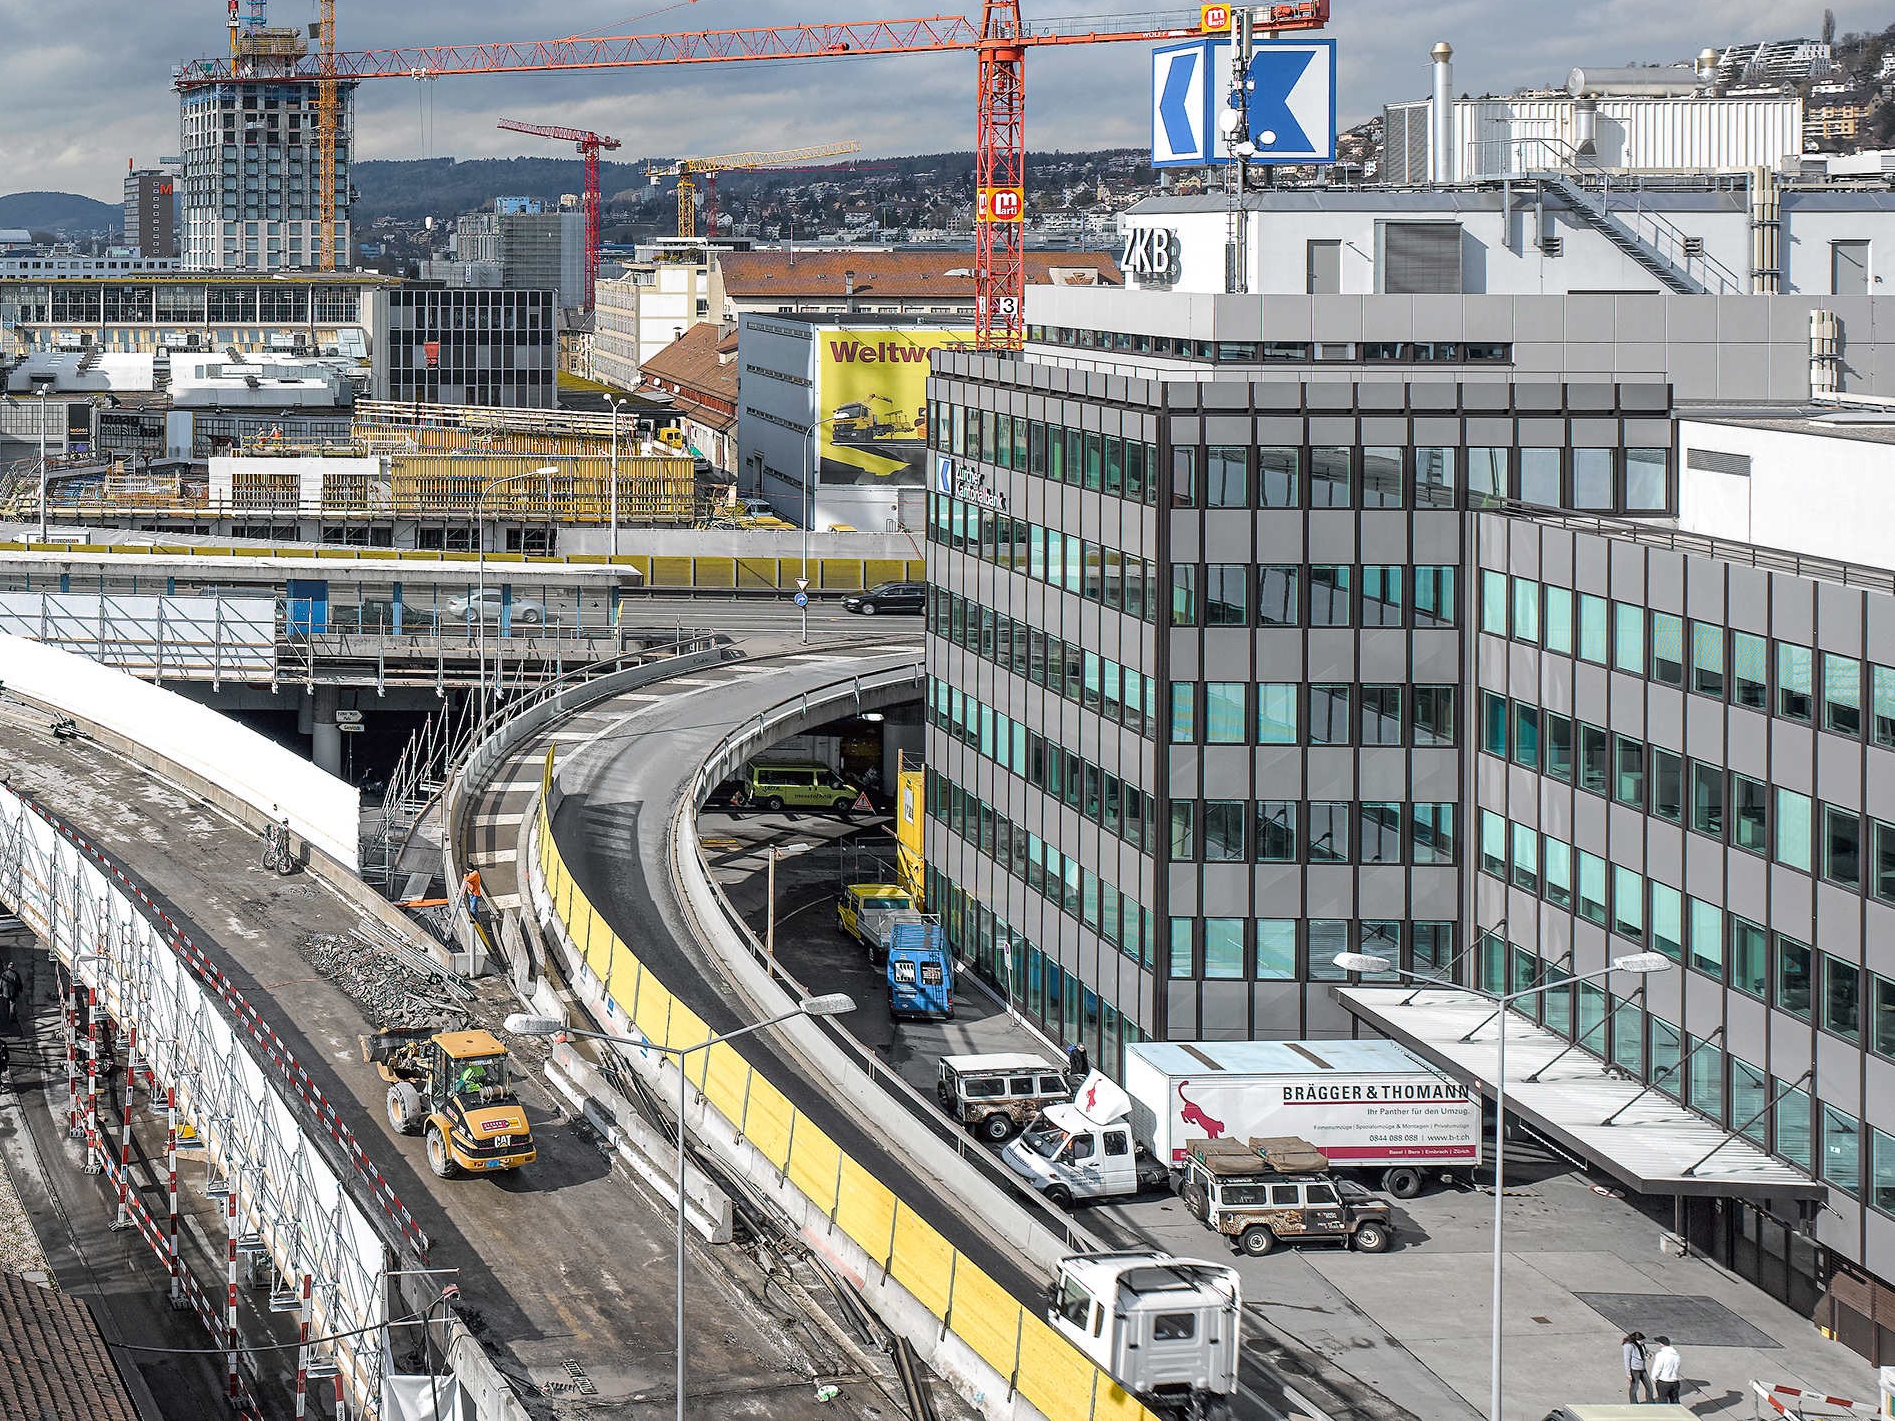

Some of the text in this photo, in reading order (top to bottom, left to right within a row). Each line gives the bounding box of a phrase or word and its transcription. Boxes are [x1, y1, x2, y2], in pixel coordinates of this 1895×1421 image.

[159, 183, 173, 196] M
[1121, 228, 1169, 273] ZKB
[1003, 298, 1015, 314] 3
[1283, 1083, 1469, 1101] BRÄGGER & THOMANN
[1367, 1107, 1470, 1117] Ihr Panther für den Umzug.
[494, 1134, 511, 1148] CAT
[1369, 1133, 1470, 1142] 0844 088 088 www.b-t.ch
